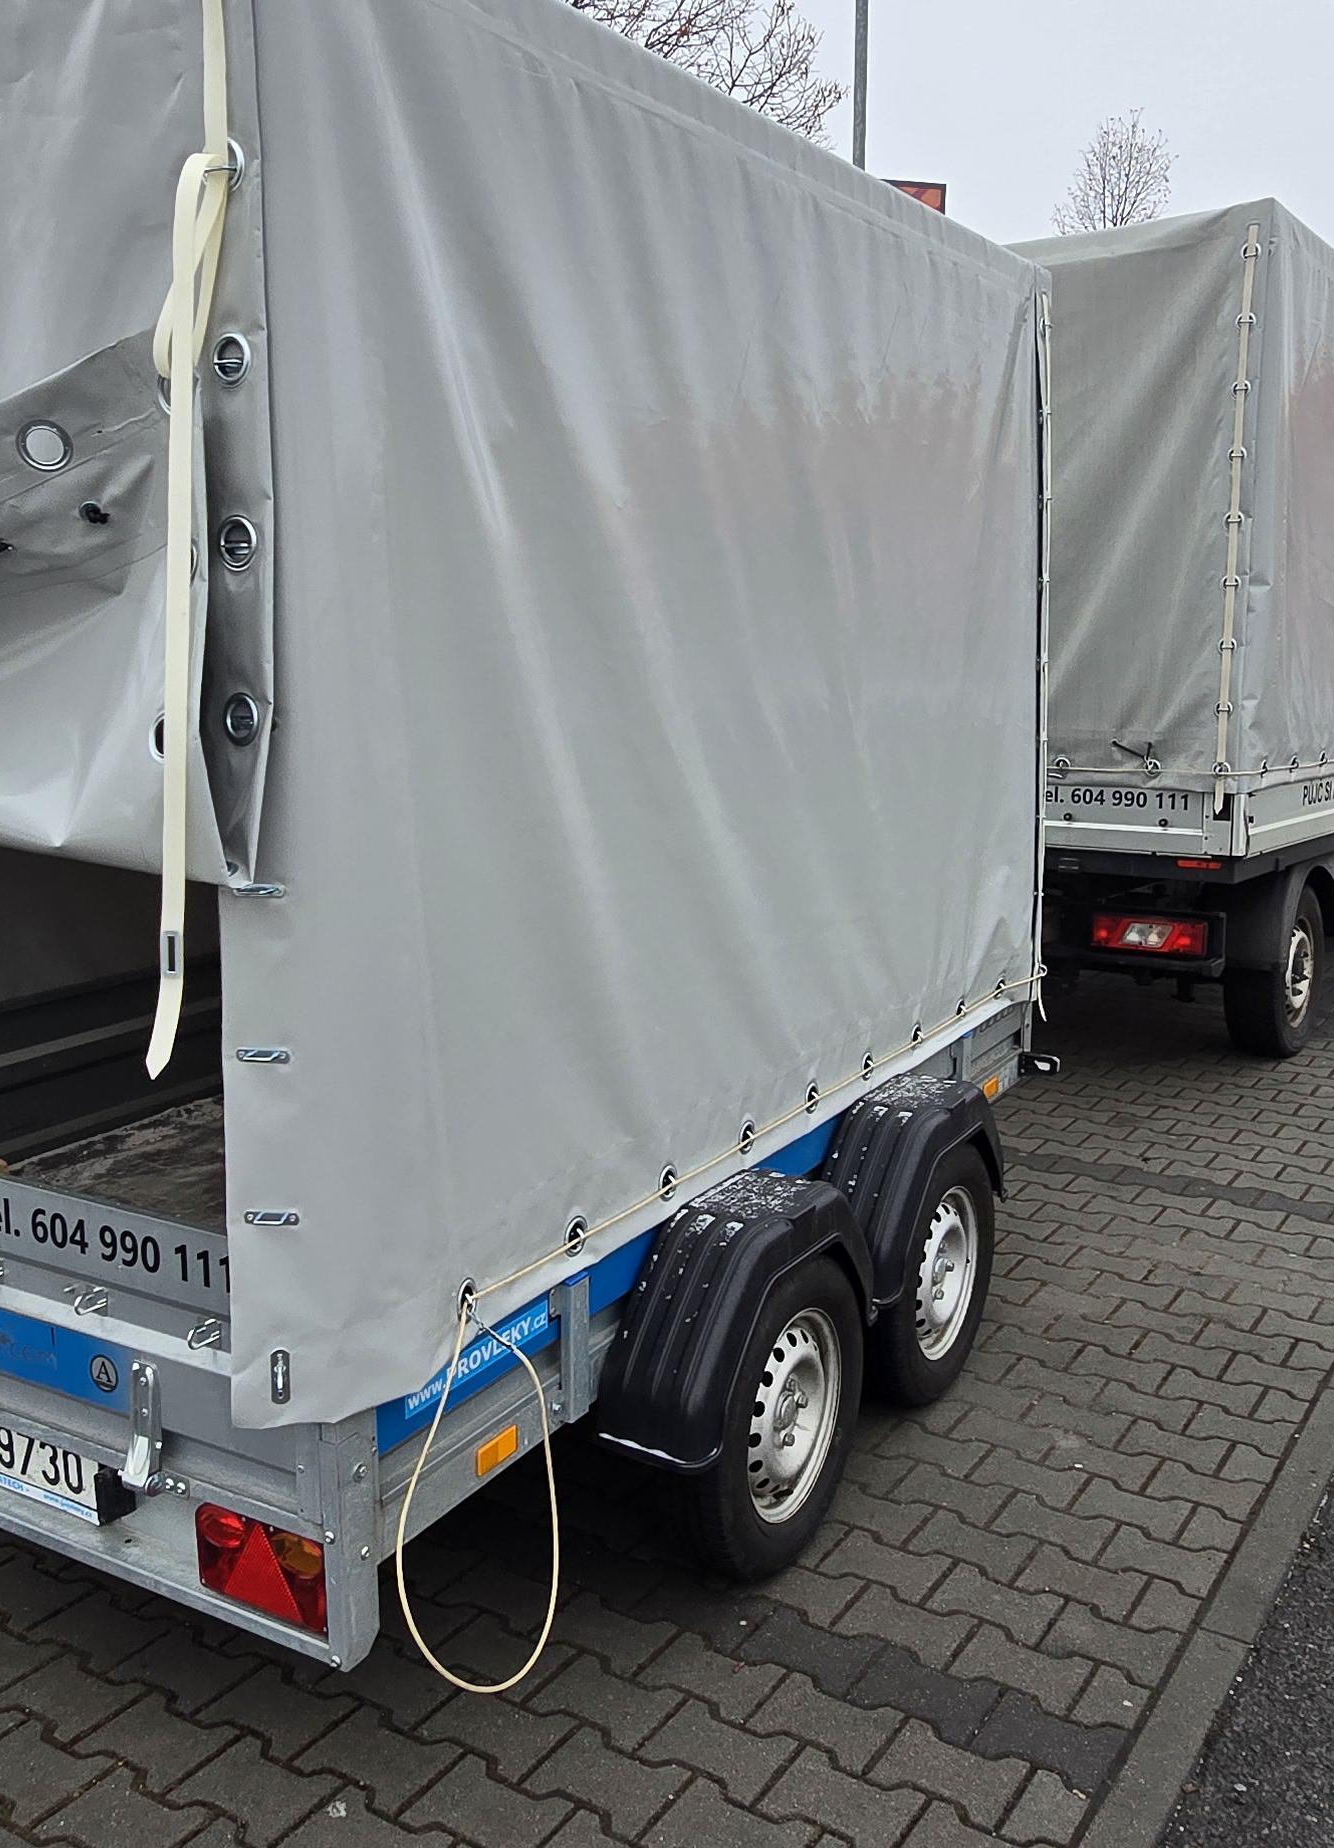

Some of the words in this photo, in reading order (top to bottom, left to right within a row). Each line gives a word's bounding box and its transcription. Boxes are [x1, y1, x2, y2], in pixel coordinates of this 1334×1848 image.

[1045, 786, 1064, 803] el.
[1071, 788, 1105, 805] 604
[1112, 790, 1148, 808] 990
[1155, 793, 1189, 811] 111
[31, 1208, 89, 1255] 604
[99, 1225, 160, 1273] 990
